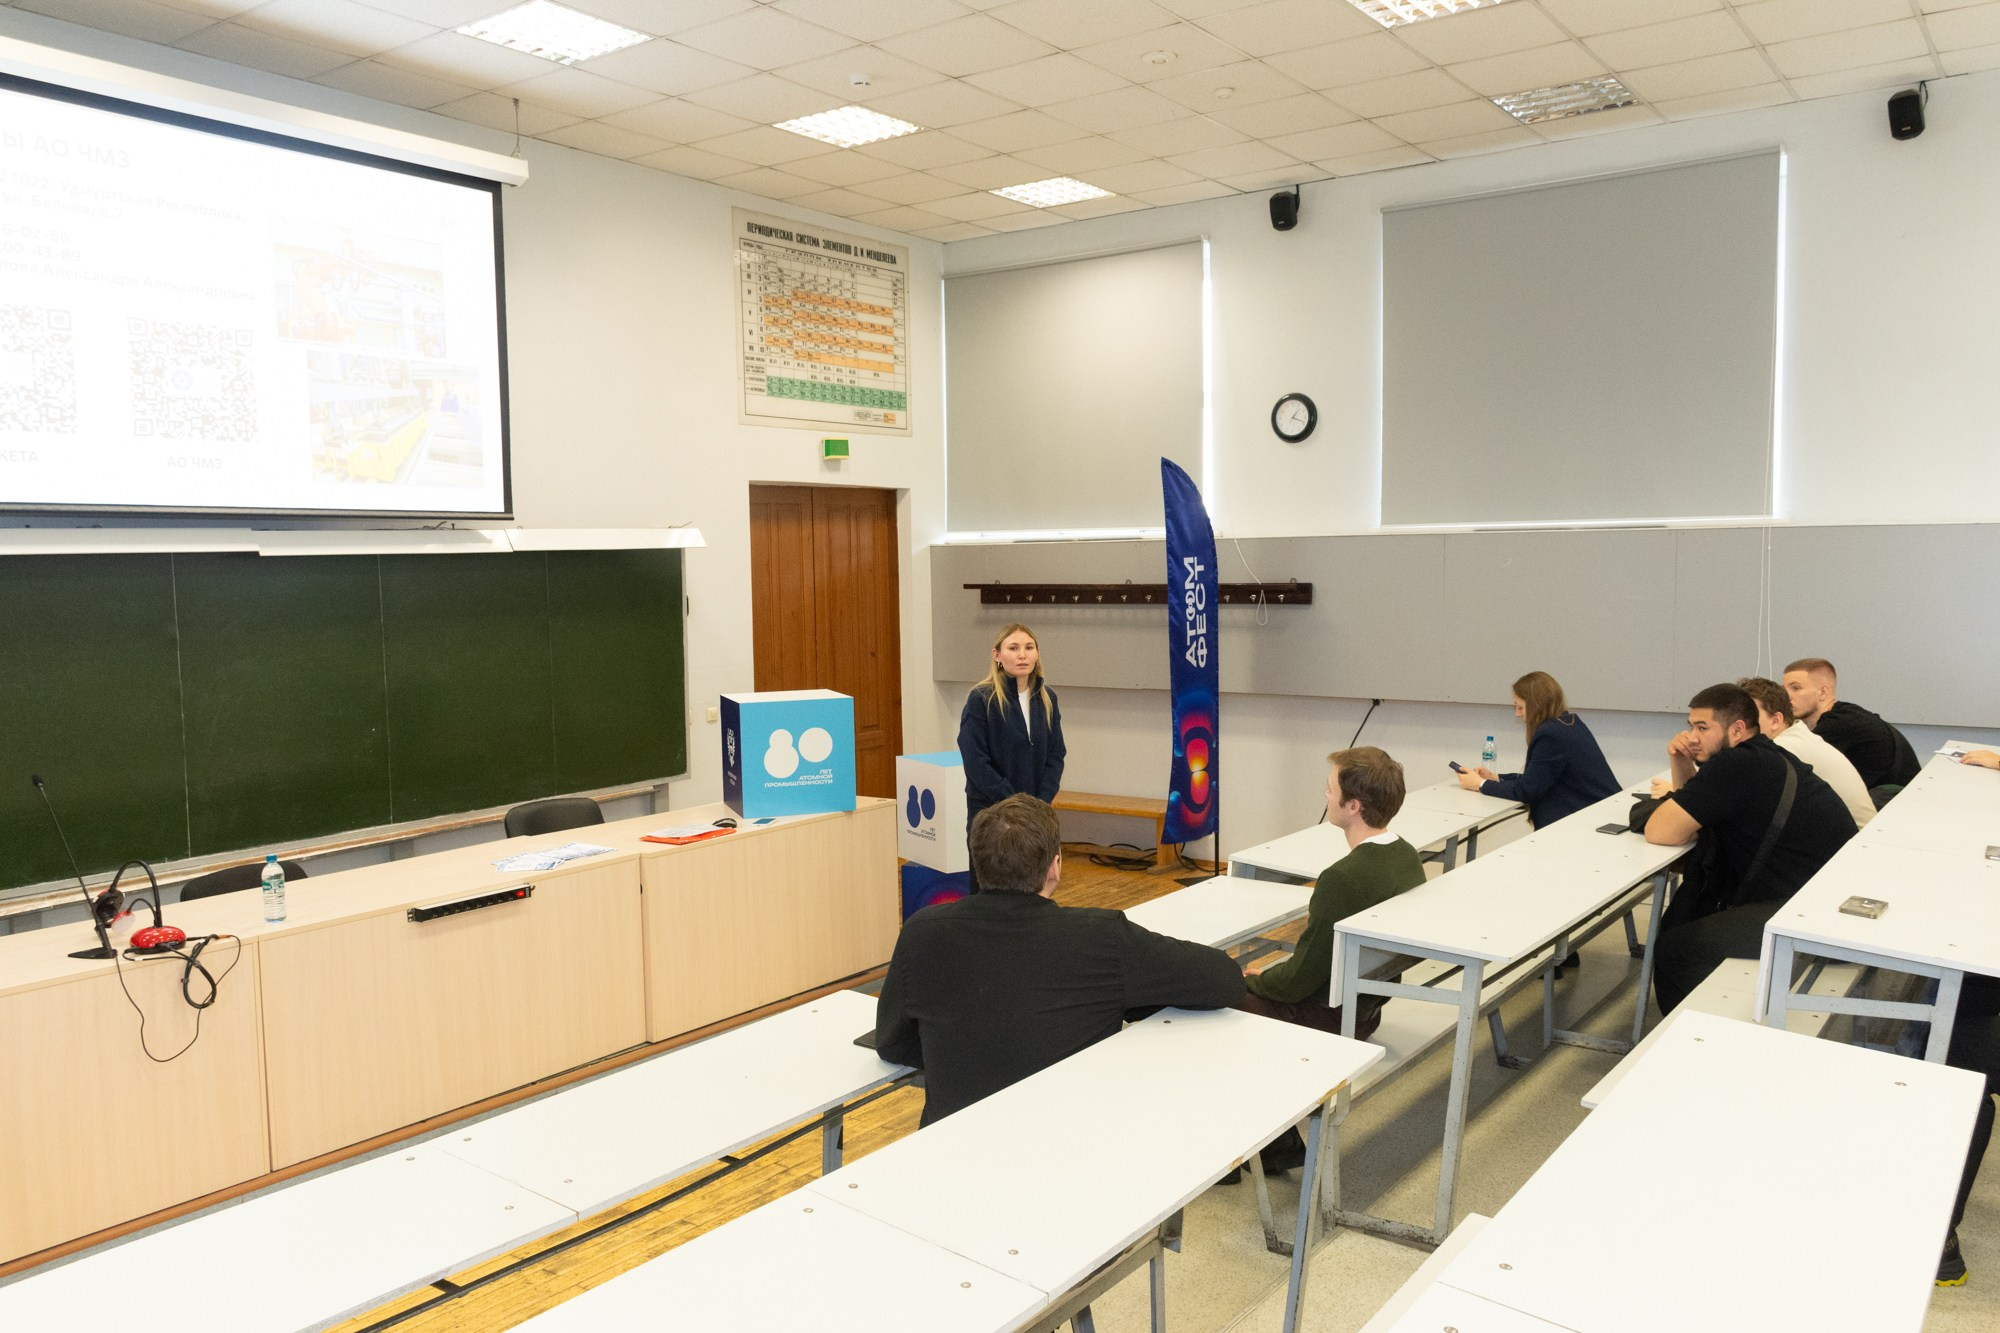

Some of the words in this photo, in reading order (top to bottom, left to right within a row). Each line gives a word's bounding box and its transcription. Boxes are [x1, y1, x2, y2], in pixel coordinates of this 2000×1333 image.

[0, 128, 24, 151] Ы
[33, 135, 70, 157] АО
[77, 142, 131, 168] ЧМЗ
[0, 240, 81, 262] 00-43-89
[747, 222, 793, 242] ПЕРИОДИЧЕСКАЯ
[796, 233, 820, 247] СИСТЕМА
[823, 239, 852, 255] ЭЛЕМЕНТОВ
[866, 249, 896, 265] МЕНДЕЛЕЕВА
[166, 455, 188, 468] АО
[191, 457, 223, 470] ЧМЗ
[1194, 556, 1208, 668] ФЕСТ
[819, 768, 833, 776] ЛЕТ
[764, 779, 833, 788] ПРОМЫШЛЕННОСТИ
